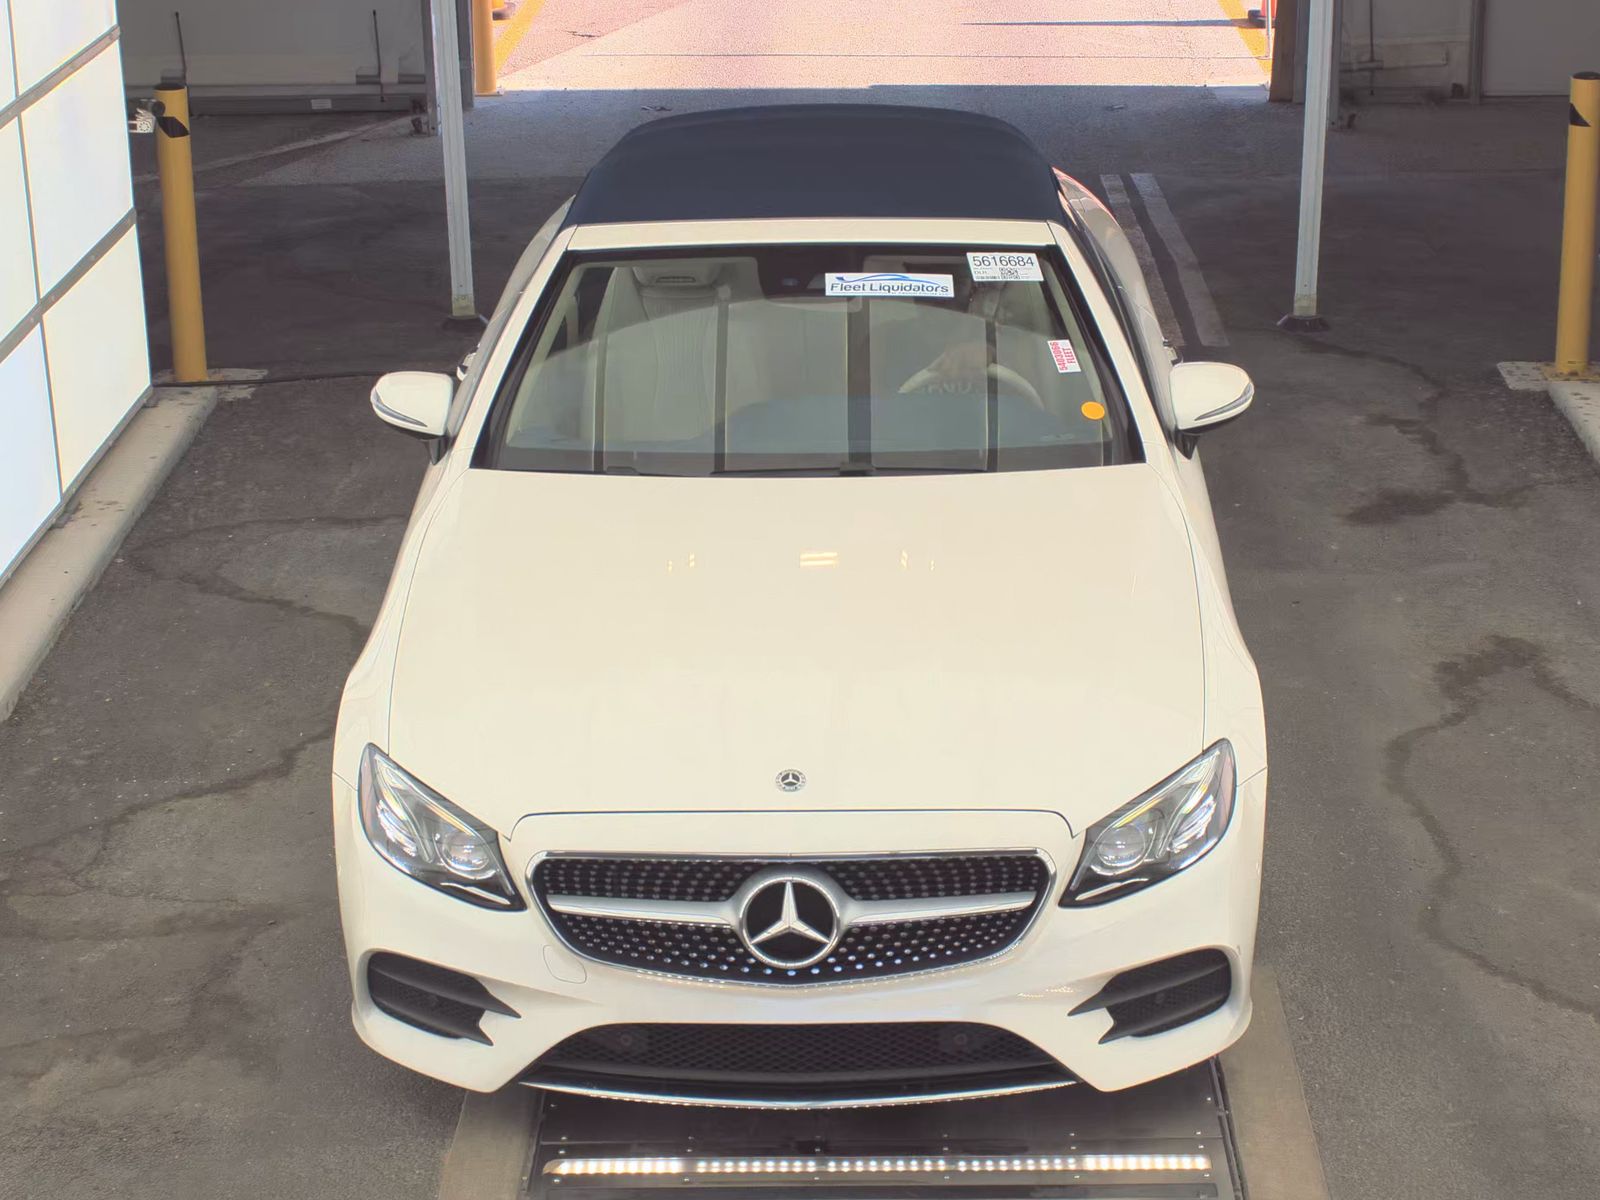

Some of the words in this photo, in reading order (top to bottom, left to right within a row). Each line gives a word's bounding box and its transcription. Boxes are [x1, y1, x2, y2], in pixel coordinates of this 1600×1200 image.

[972, 255, 1034, 267] 5616684
[830, 283, 867, 292] Fleet
[869, 282, 949, 293] Liquidators
[1062, 348, 1077, 364] FLEET
